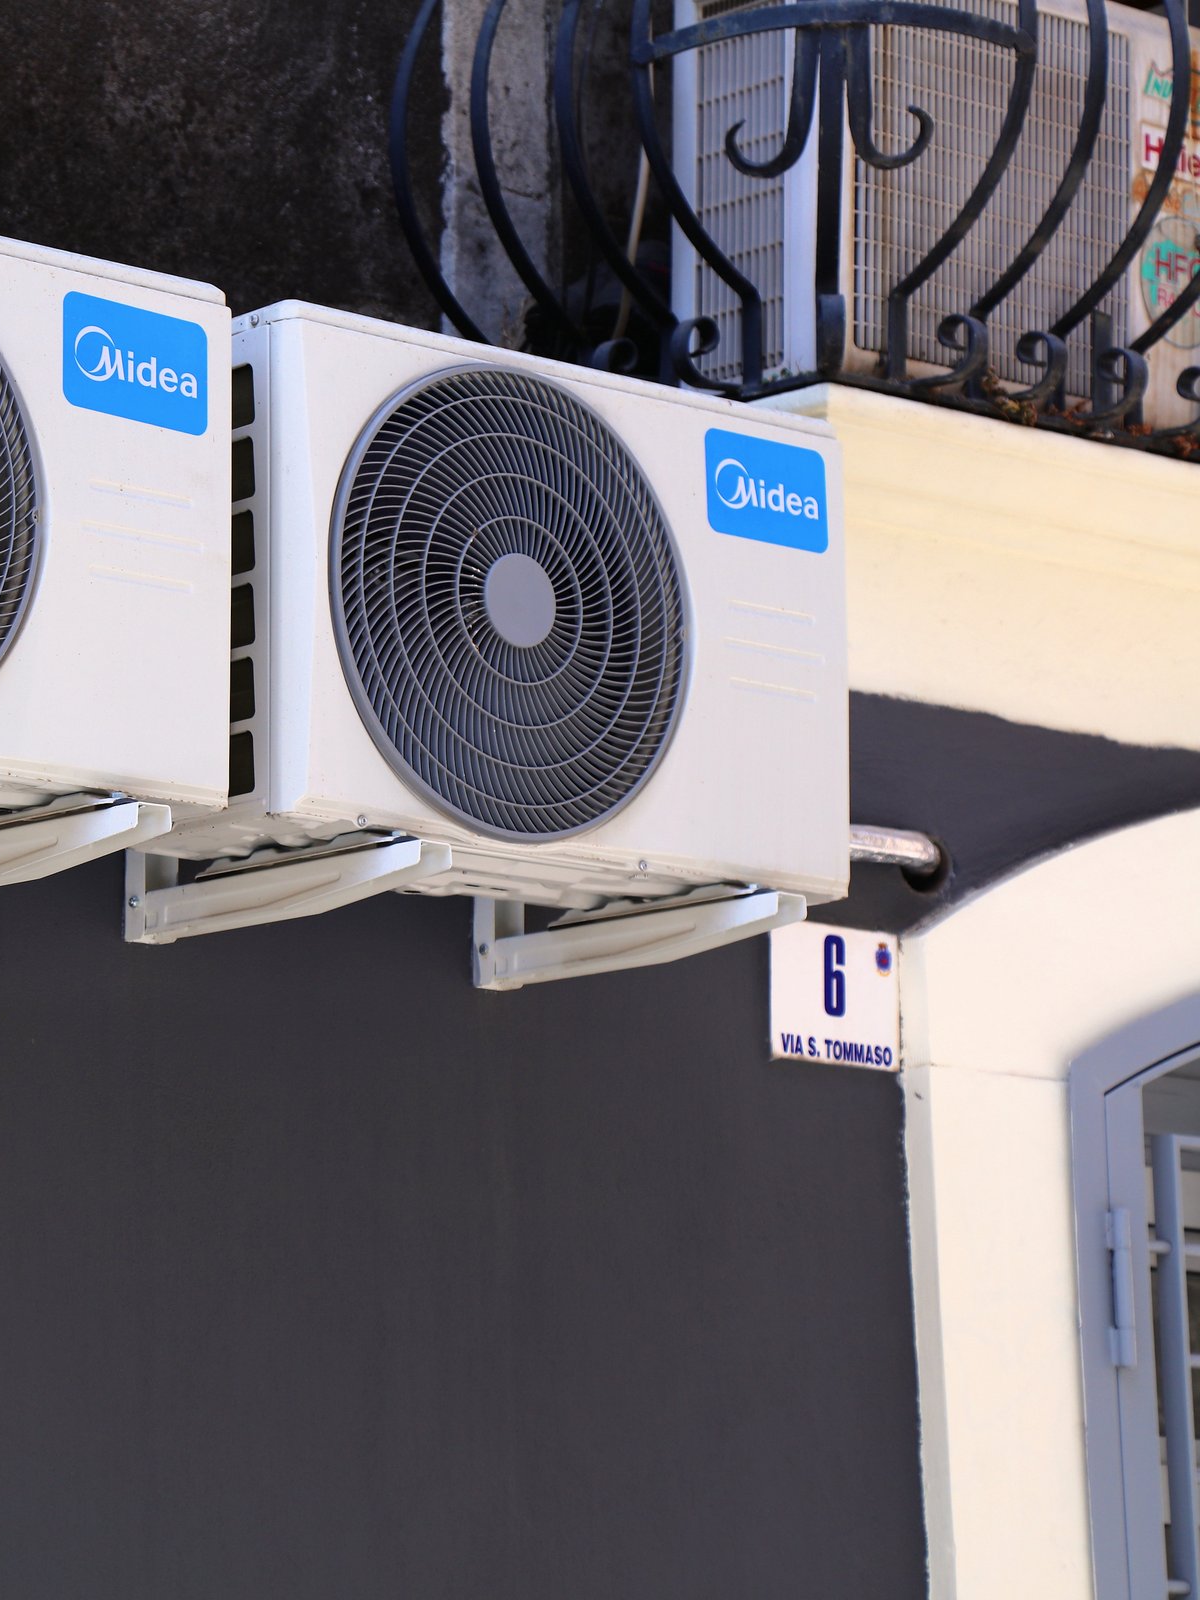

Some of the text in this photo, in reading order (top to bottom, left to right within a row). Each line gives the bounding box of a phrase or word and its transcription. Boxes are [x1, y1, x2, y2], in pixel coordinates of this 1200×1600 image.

[74, 325, 198, 399] Midea
[715, 458, 819, 521] Midea
[823, 934, 846, 1017] 6
[781, 1032, 893, 1068] VIA S. TOMMASO
